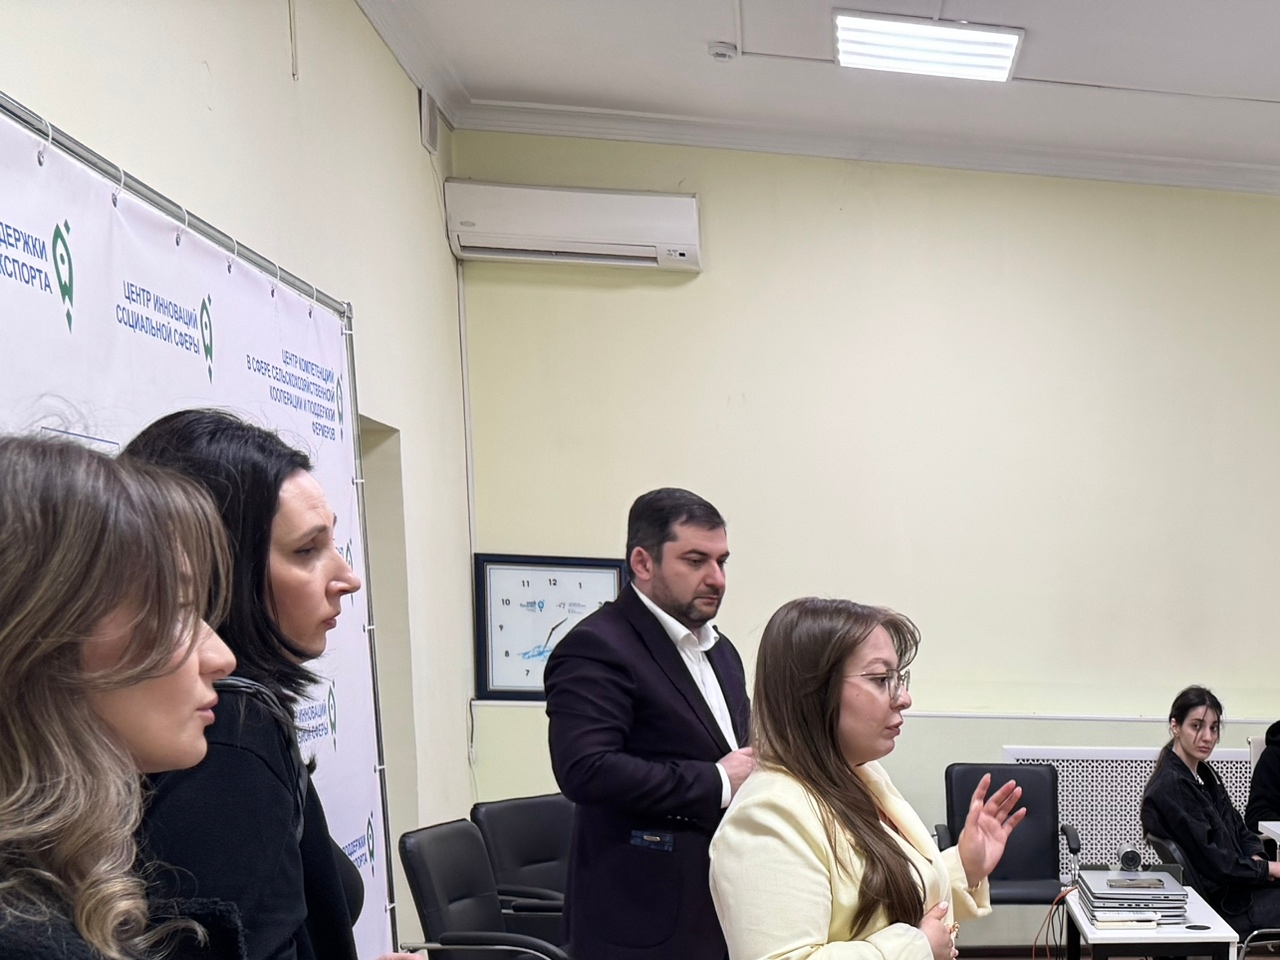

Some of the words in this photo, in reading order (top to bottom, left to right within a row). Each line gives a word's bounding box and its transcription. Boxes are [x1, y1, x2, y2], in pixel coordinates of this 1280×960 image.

[123, 280, 152, 309] ЦЕНТР
[153, 293, 199, 330] ИННОВАЦИЙ
[115, 304, 173, 344] СОЦИАЛЬНОЙ
[173, 328, 200, 355] СФЕРЫ
[246, 354, 252, 370] В
[252, 357, 271, 378] СФЕРЕ
[281, 348, 298, 369] ЦЕНТР
